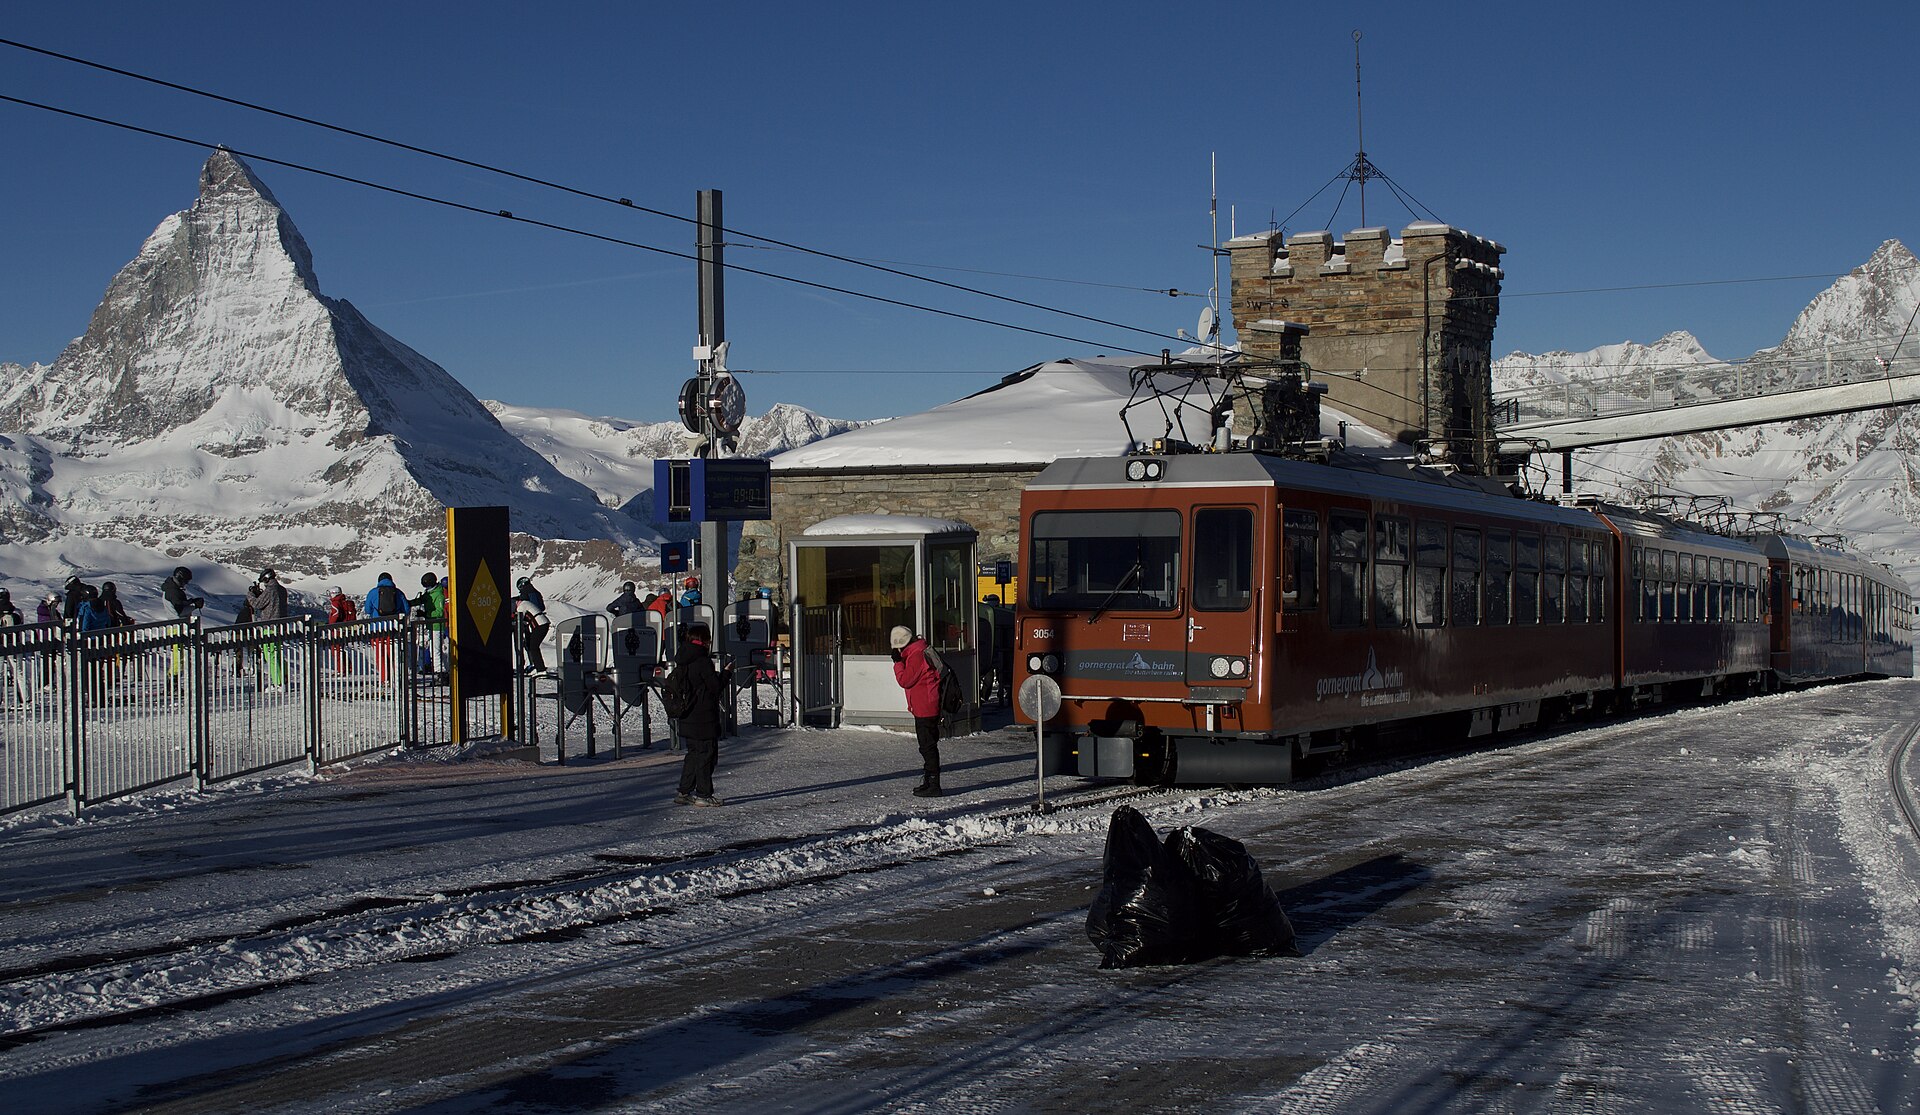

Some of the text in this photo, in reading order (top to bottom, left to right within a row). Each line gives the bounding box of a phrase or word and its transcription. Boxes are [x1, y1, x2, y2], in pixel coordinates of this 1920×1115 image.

[477, 596, 492, 607] 360
[1033, 629, 1055, 639] 3054
[1079, 660, 1175, 670] gornergrat bahn
[1316, 666, 1404, 701] gornergrat bahn
[1361, 693, 1369, 706] the
